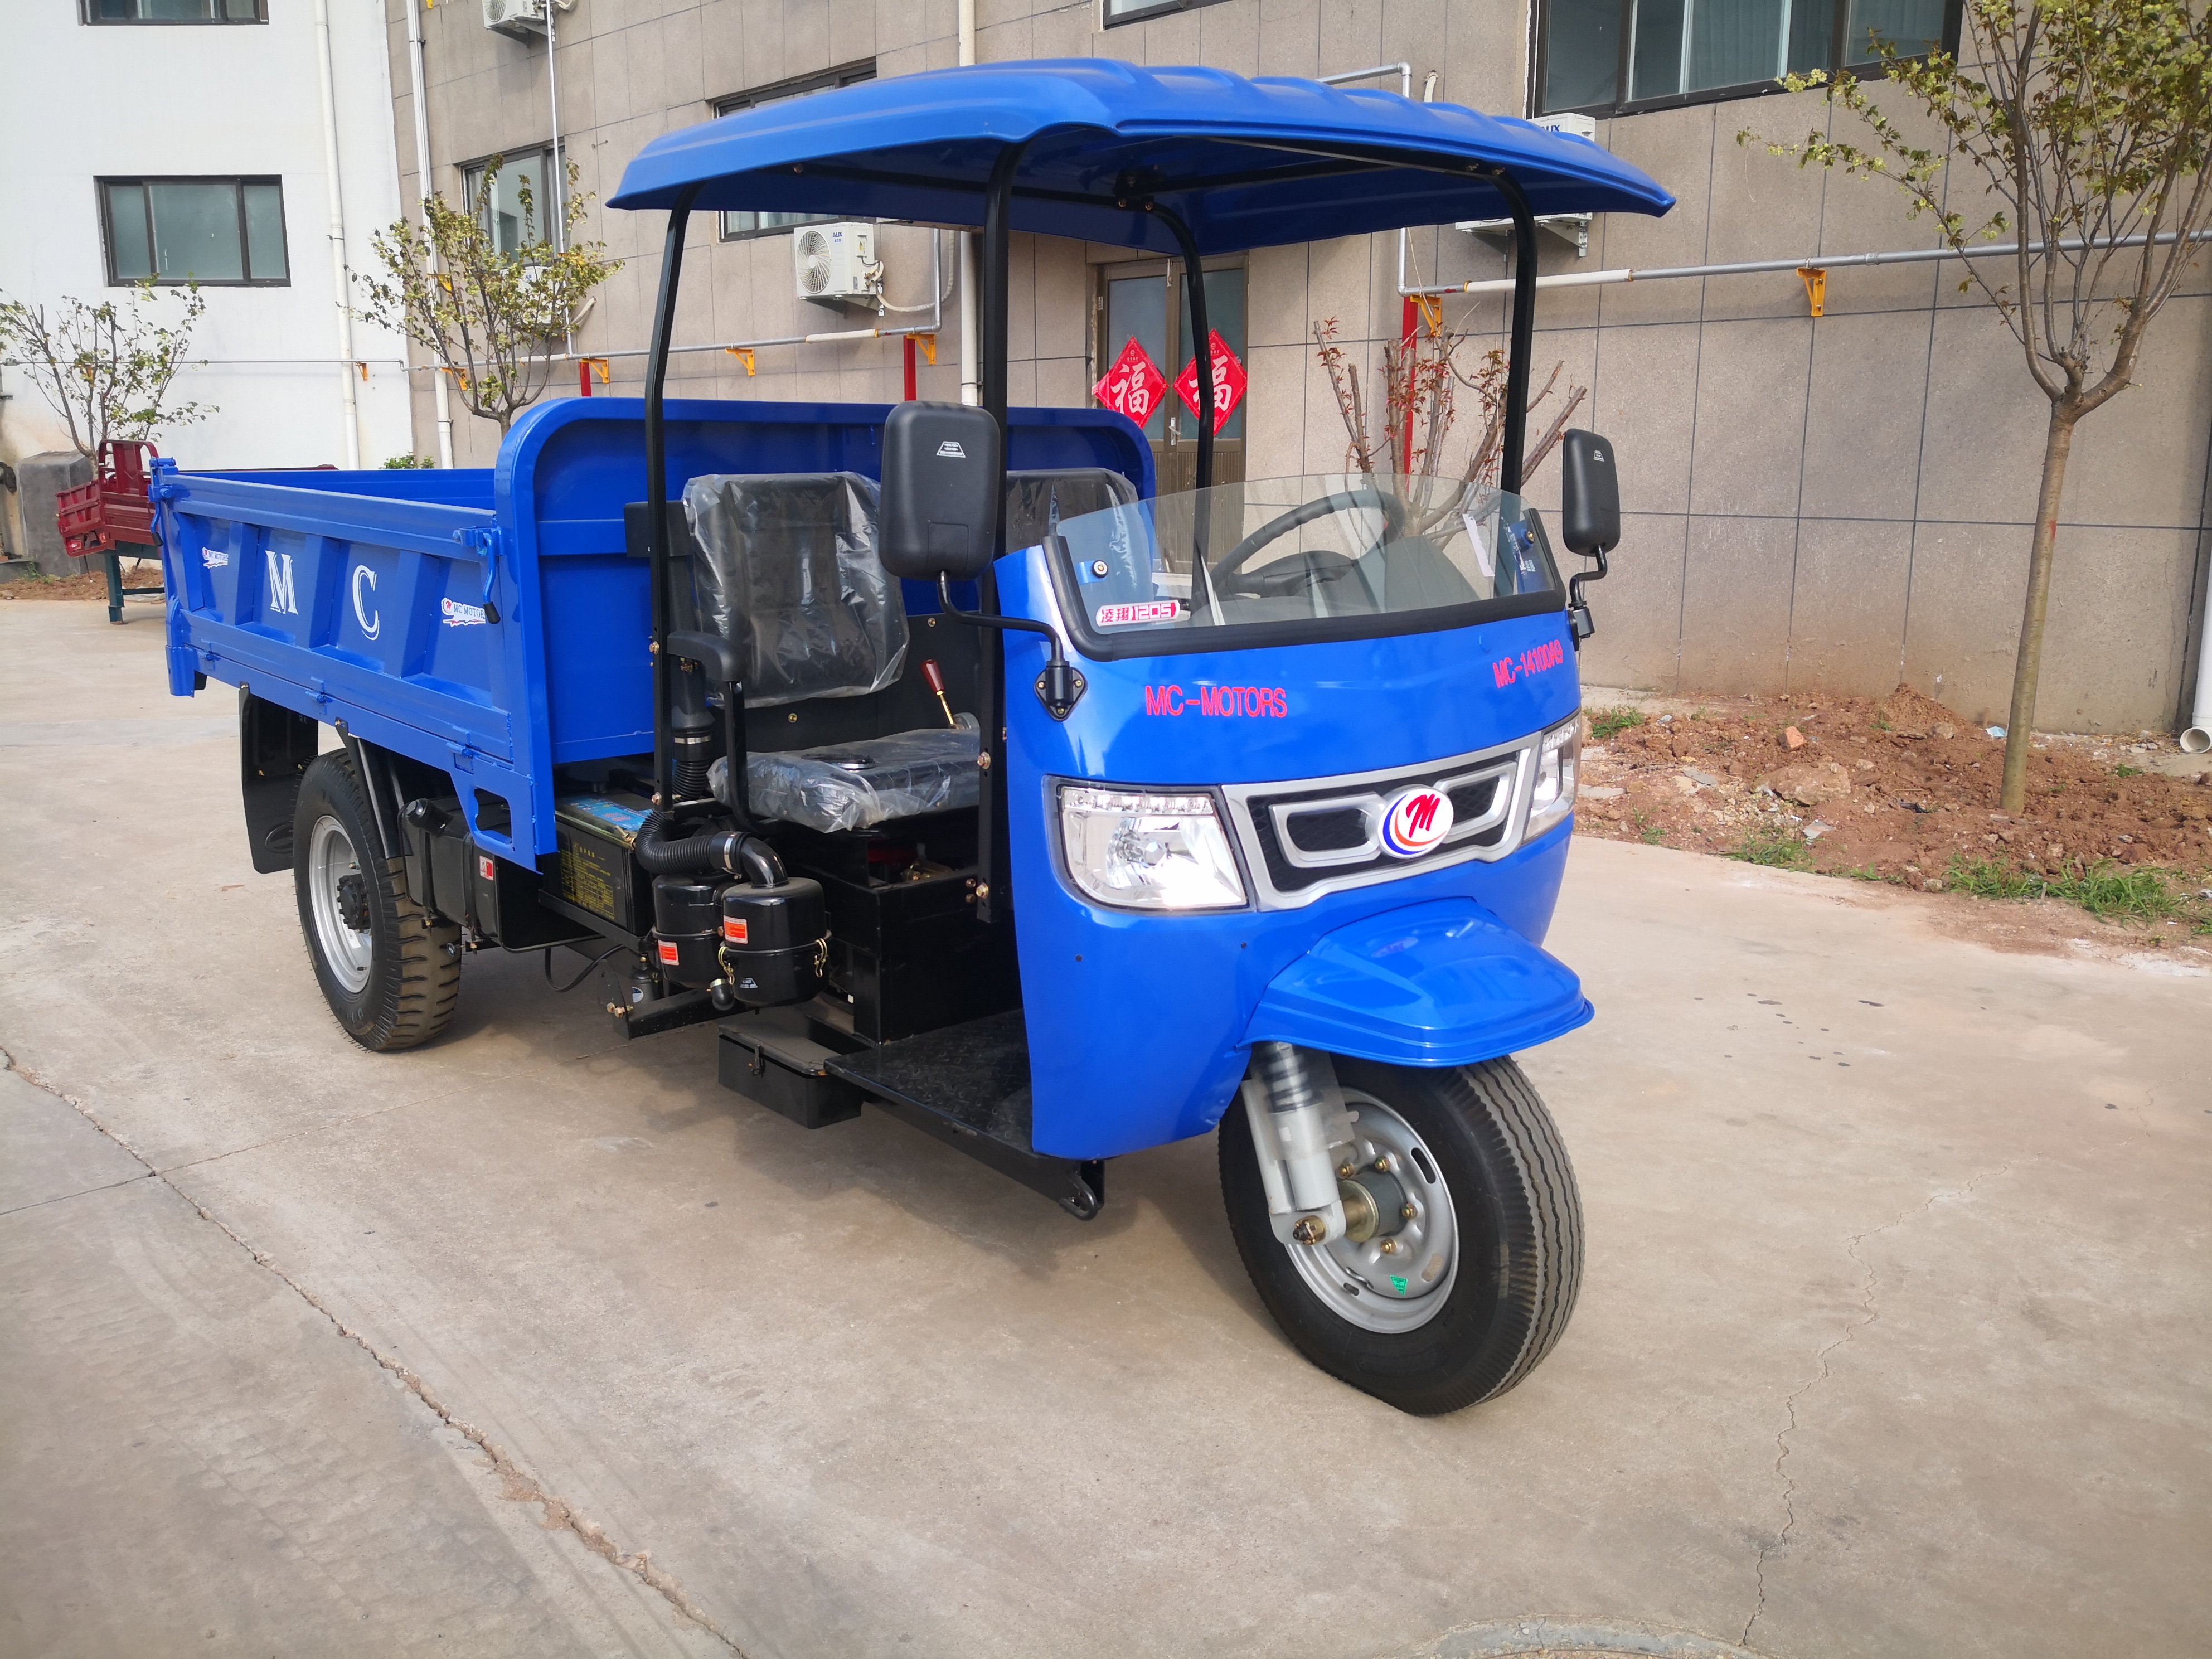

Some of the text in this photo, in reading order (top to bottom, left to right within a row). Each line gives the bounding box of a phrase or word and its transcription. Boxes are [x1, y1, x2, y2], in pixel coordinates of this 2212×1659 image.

[1110, 361, 1149, 415] 福
[265, 550, 380, 641] M C
[453, 603, 462, 614] MC
[1134, 603, 1172, 621] 1205
[1145, 685, 1288, 718] MC-MOTORS
